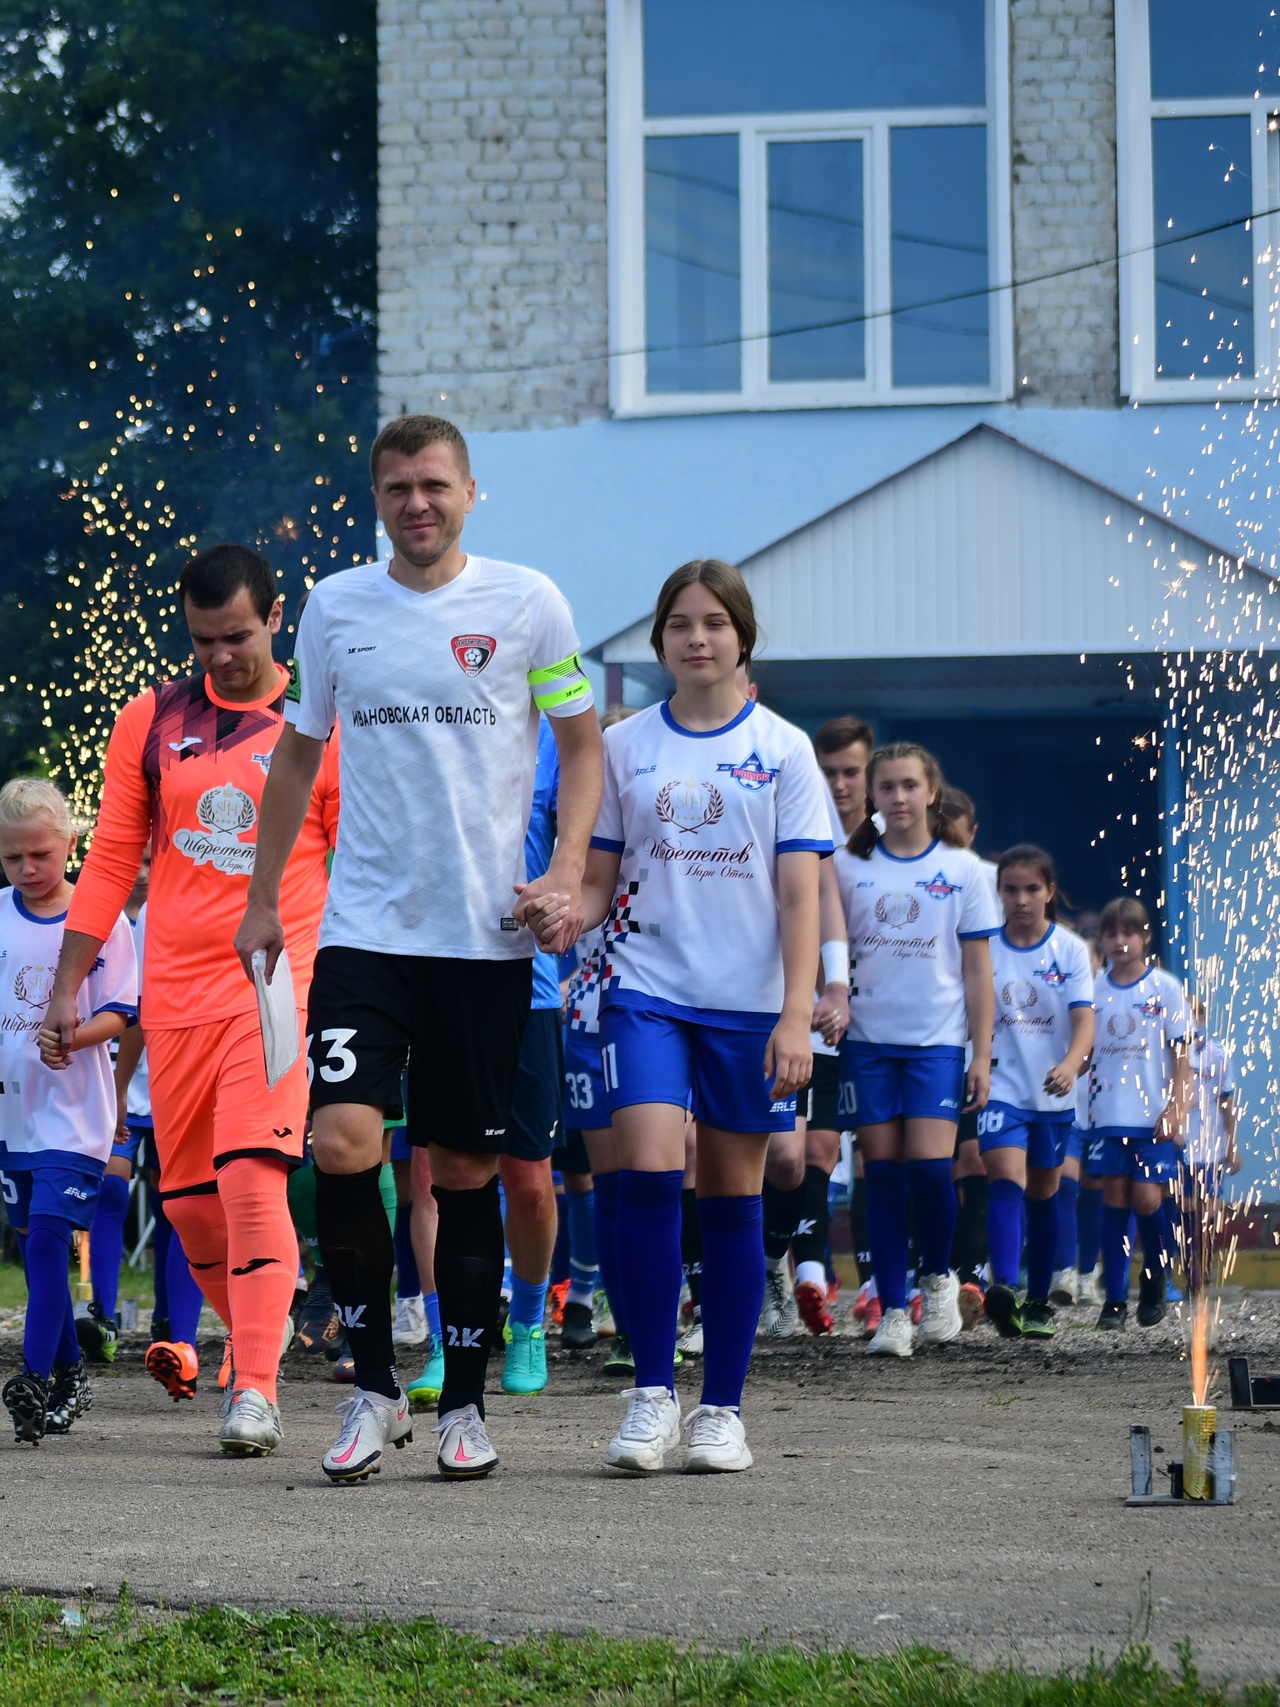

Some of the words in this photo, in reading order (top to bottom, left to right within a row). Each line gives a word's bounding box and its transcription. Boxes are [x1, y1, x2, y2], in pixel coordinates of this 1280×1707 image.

[351, 706, 429, 728] ИВАНОВСКАЯ
[434, 706, 497, 726] ОБЛАСТЬ
[216, 857, 244, 873] Парк
[643, 836, 754, 868] Шереметев
[679, 863, 715, 882] Парк
[721, 865, 754, 879] Отель
[307, 1028, 358, 1083] 3
[565, 1072, 594, 1109] 33
